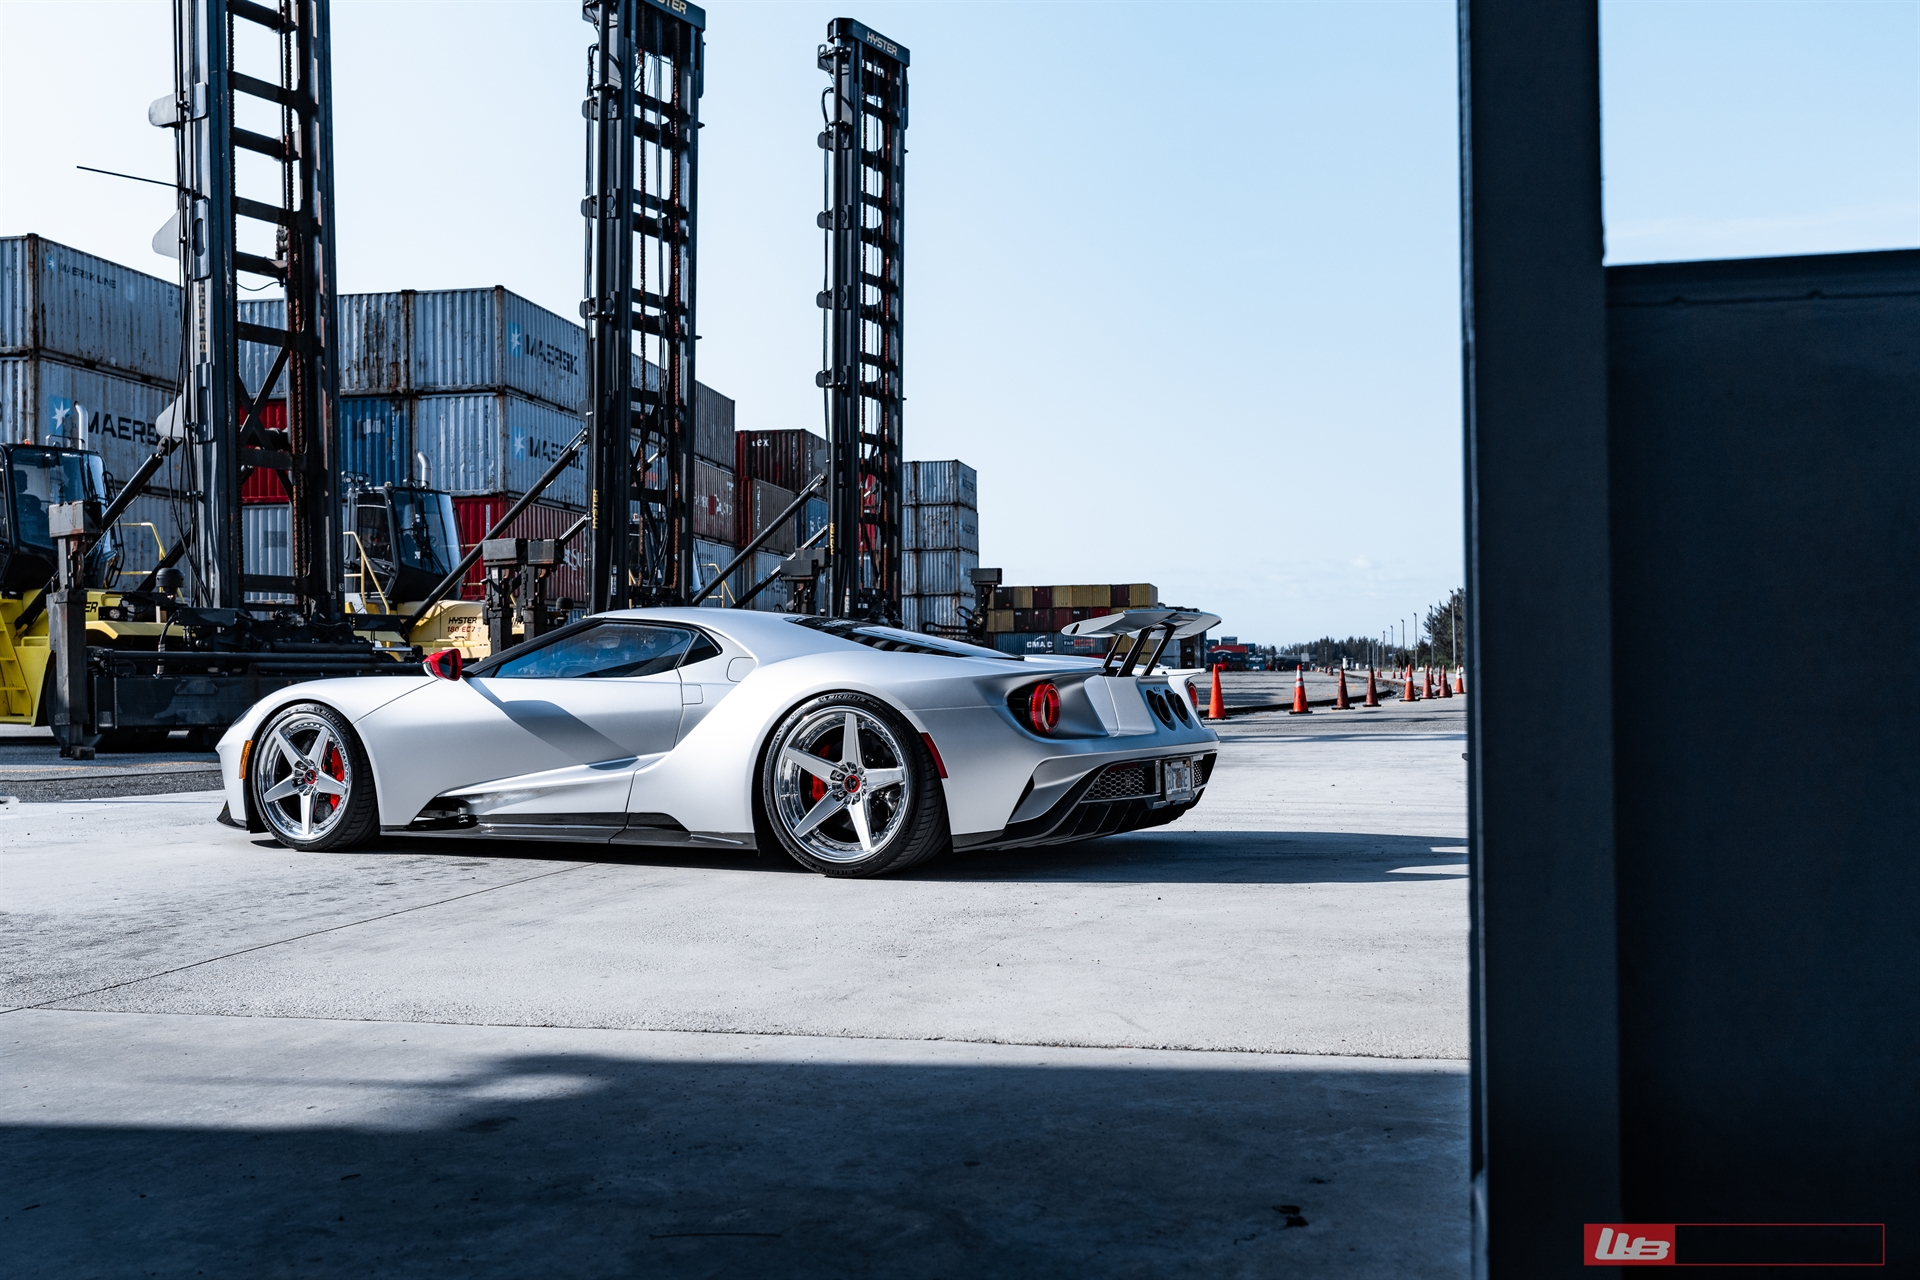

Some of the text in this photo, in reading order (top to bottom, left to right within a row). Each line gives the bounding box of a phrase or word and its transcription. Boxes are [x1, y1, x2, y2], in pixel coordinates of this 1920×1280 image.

[866, 31, 898, 57] HYSTER
[97, 274, 117, 289] LINE
[525, 333, 579, 376] MAERSK
[529, 436, 584, 471] MAEK
[448, 616, 478, 625] HYSTER
